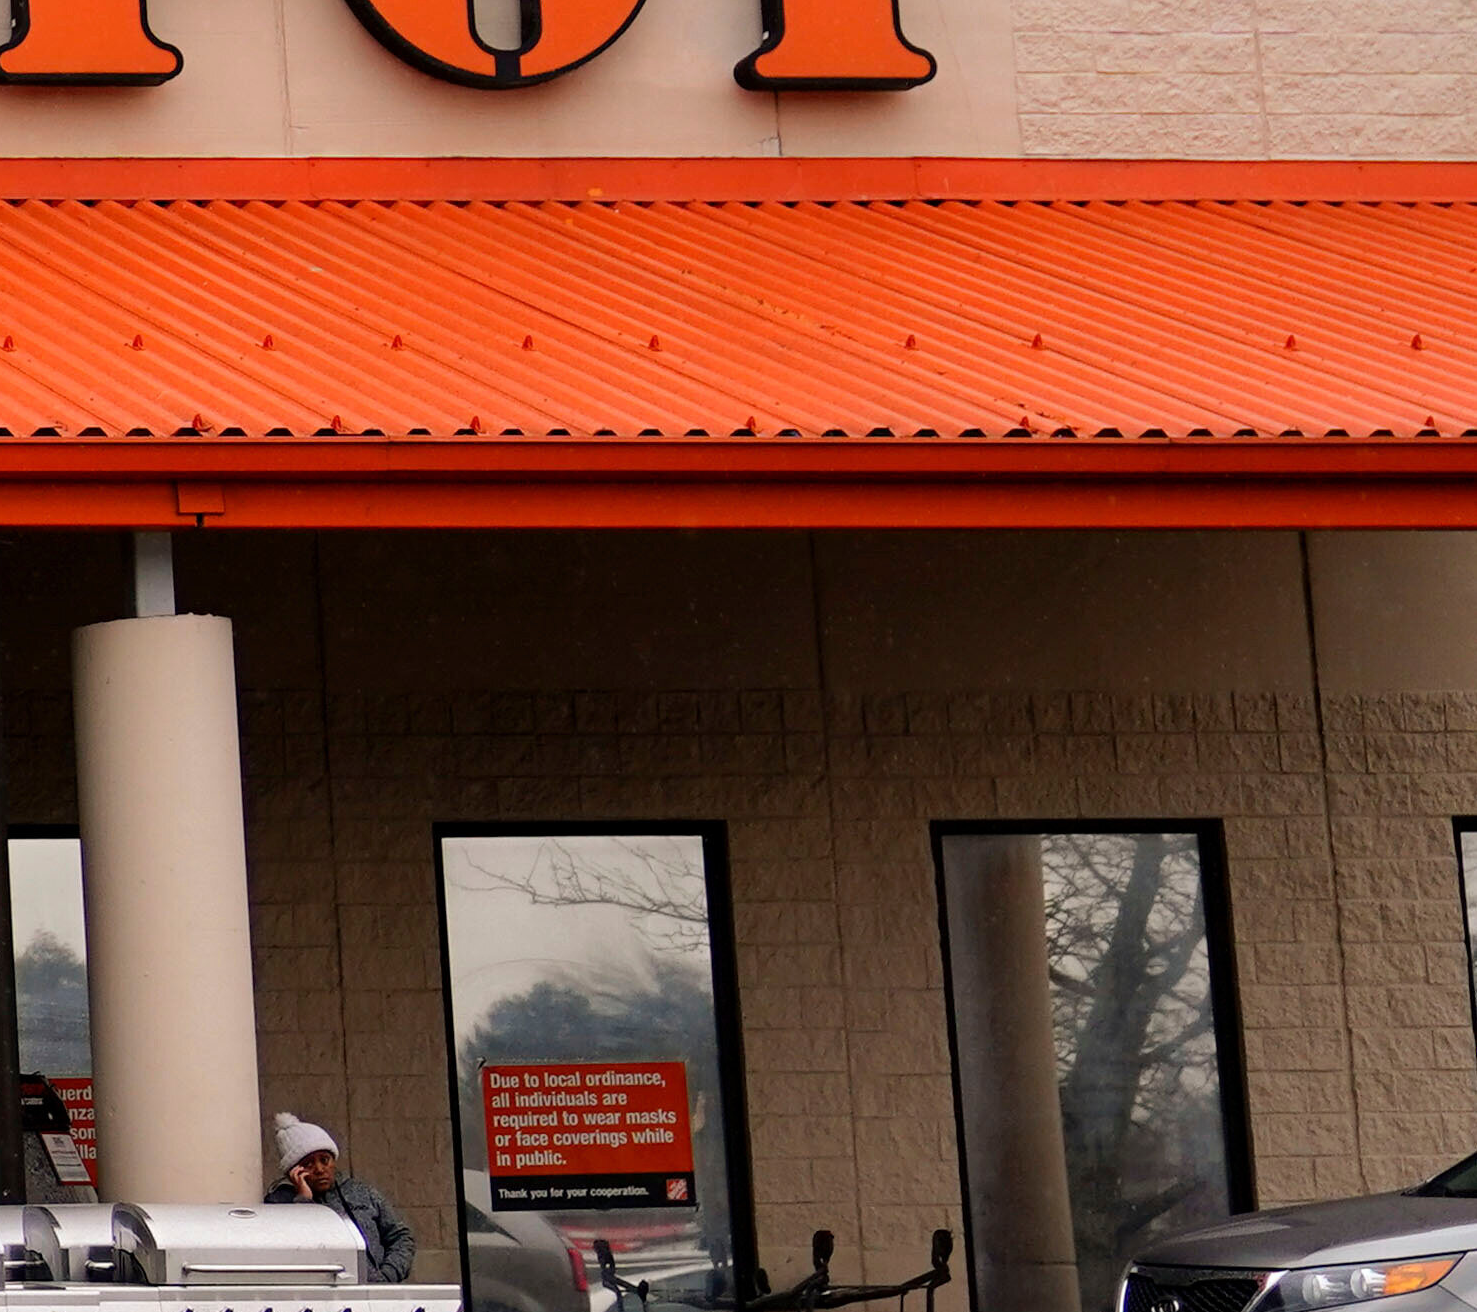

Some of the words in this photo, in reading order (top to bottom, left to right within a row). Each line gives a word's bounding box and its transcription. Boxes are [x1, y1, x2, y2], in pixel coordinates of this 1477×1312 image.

[490, 1073, 519, 1088] Due
[524, 1072, 539, 1088] to
[544, 1072, 581, 1088] local
[585, 1071, 666, 1087] ordinance,
[492, 1092, 510, 1108] all
[515, 1091, 598, 1107] individuals
[602, 1092, 627, 1105] are
[493, 1111, 558, 1130] required
[562, 1111, 578, 1126] to
[583, 1113, 621, 1125] wear
[626, 1109, 676, 1124] masks
[495, 1133, 511, 1147] or
[516, 1131, 548, 1146] face
[553, 1129, 628, 1148] coverings
[632, 1128, 674, 1144] while
[496, 1151, 511, 1166] in
[516, 1150, 567, 1169] public.
[498, 1188, 528, 1199] Thank
[530, 1189, 548, 1200] you
[550, 1187, 564, 1198] for
[567, 1188, 587, 1199] your
[590, 1186, 649, 1198] cooperation.
